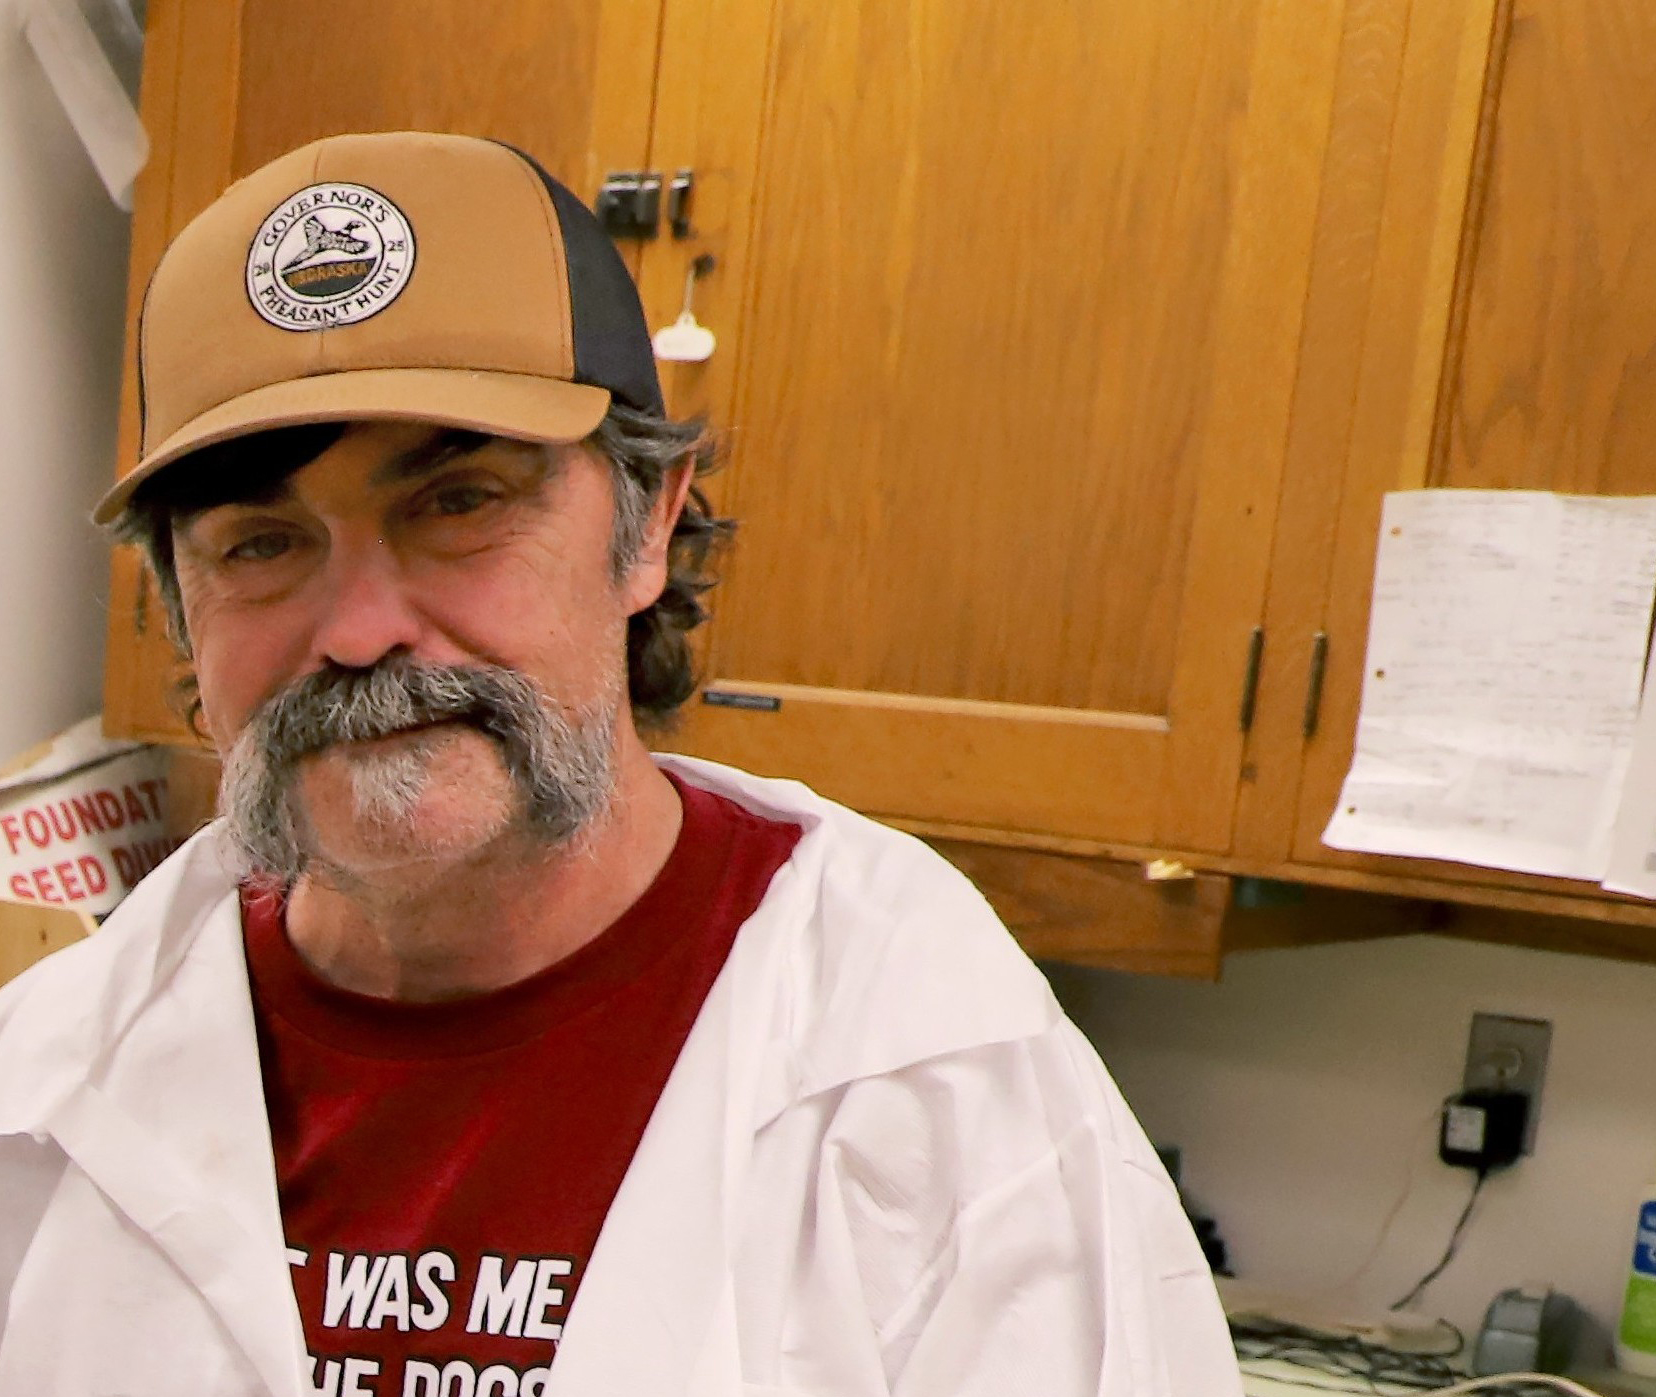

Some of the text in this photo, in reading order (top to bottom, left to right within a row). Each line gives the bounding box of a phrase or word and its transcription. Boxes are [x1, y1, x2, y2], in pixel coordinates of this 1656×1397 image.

[264, 191, 390, 246] GOVERNOR'S
[260, 262, 401, 321] PHEASANT HUNT
[9, 855, 109, 904] SEED
[323, 1250, 572, 1341] WAS ME
